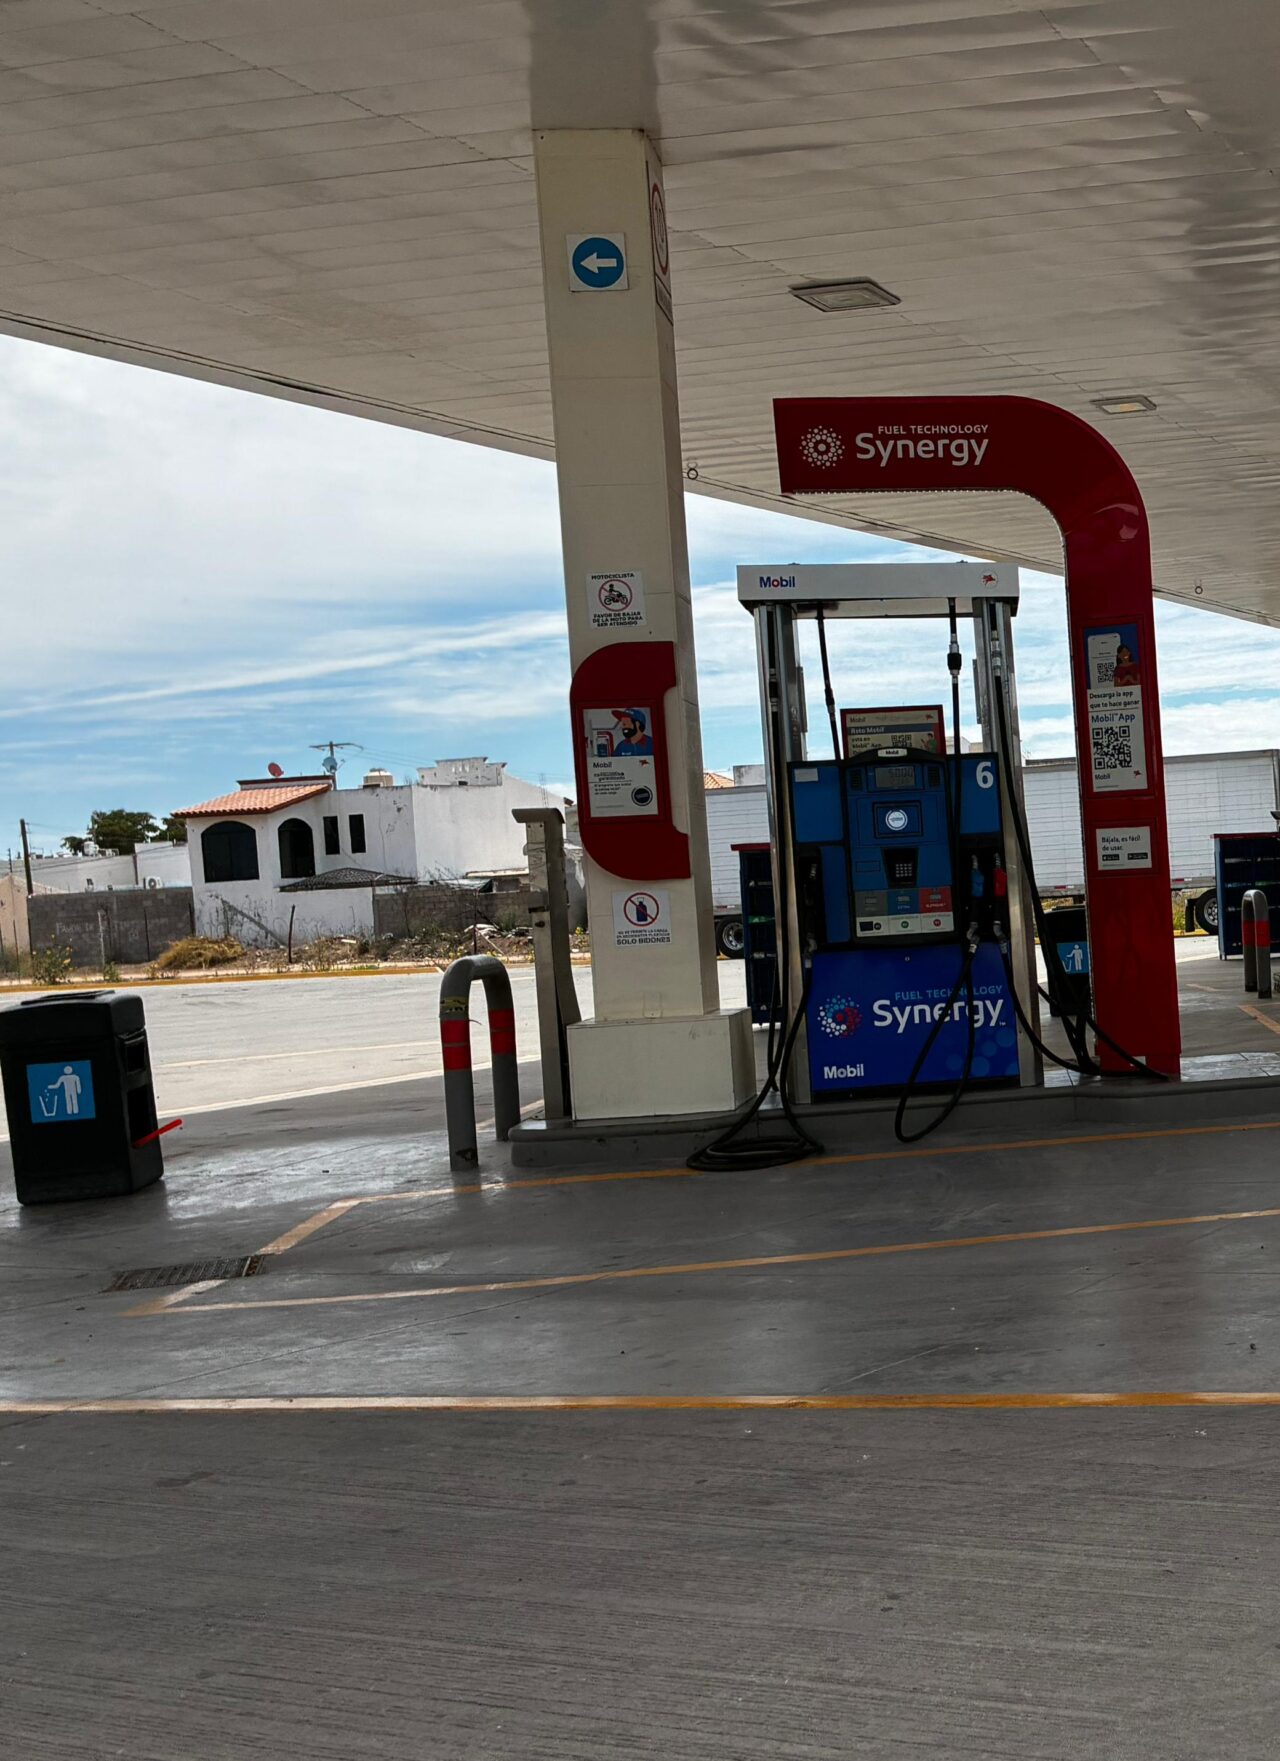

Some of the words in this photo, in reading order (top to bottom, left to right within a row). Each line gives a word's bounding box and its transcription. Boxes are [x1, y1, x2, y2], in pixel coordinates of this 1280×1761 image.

[878, 426, 907, 435] FUEL
[909, 424, 988, 434] TECHNOLOGY
[855, 432, 989, 467] Synergy
[759, 575, 795, 588] Mobil
[1089, 692, 1115, 700] Descarga
[1122, 690, 1134, 698] app
[1123, 699, 1140, 707] ganar
[1118, 711, 1136, 723] App
[975, 761, 994, 789] 6
[1094, 772, 1111, 780] Mobil
[895, 990, 923, 1001] FUEL
[823, 1064, 865, 1079] Mobil
